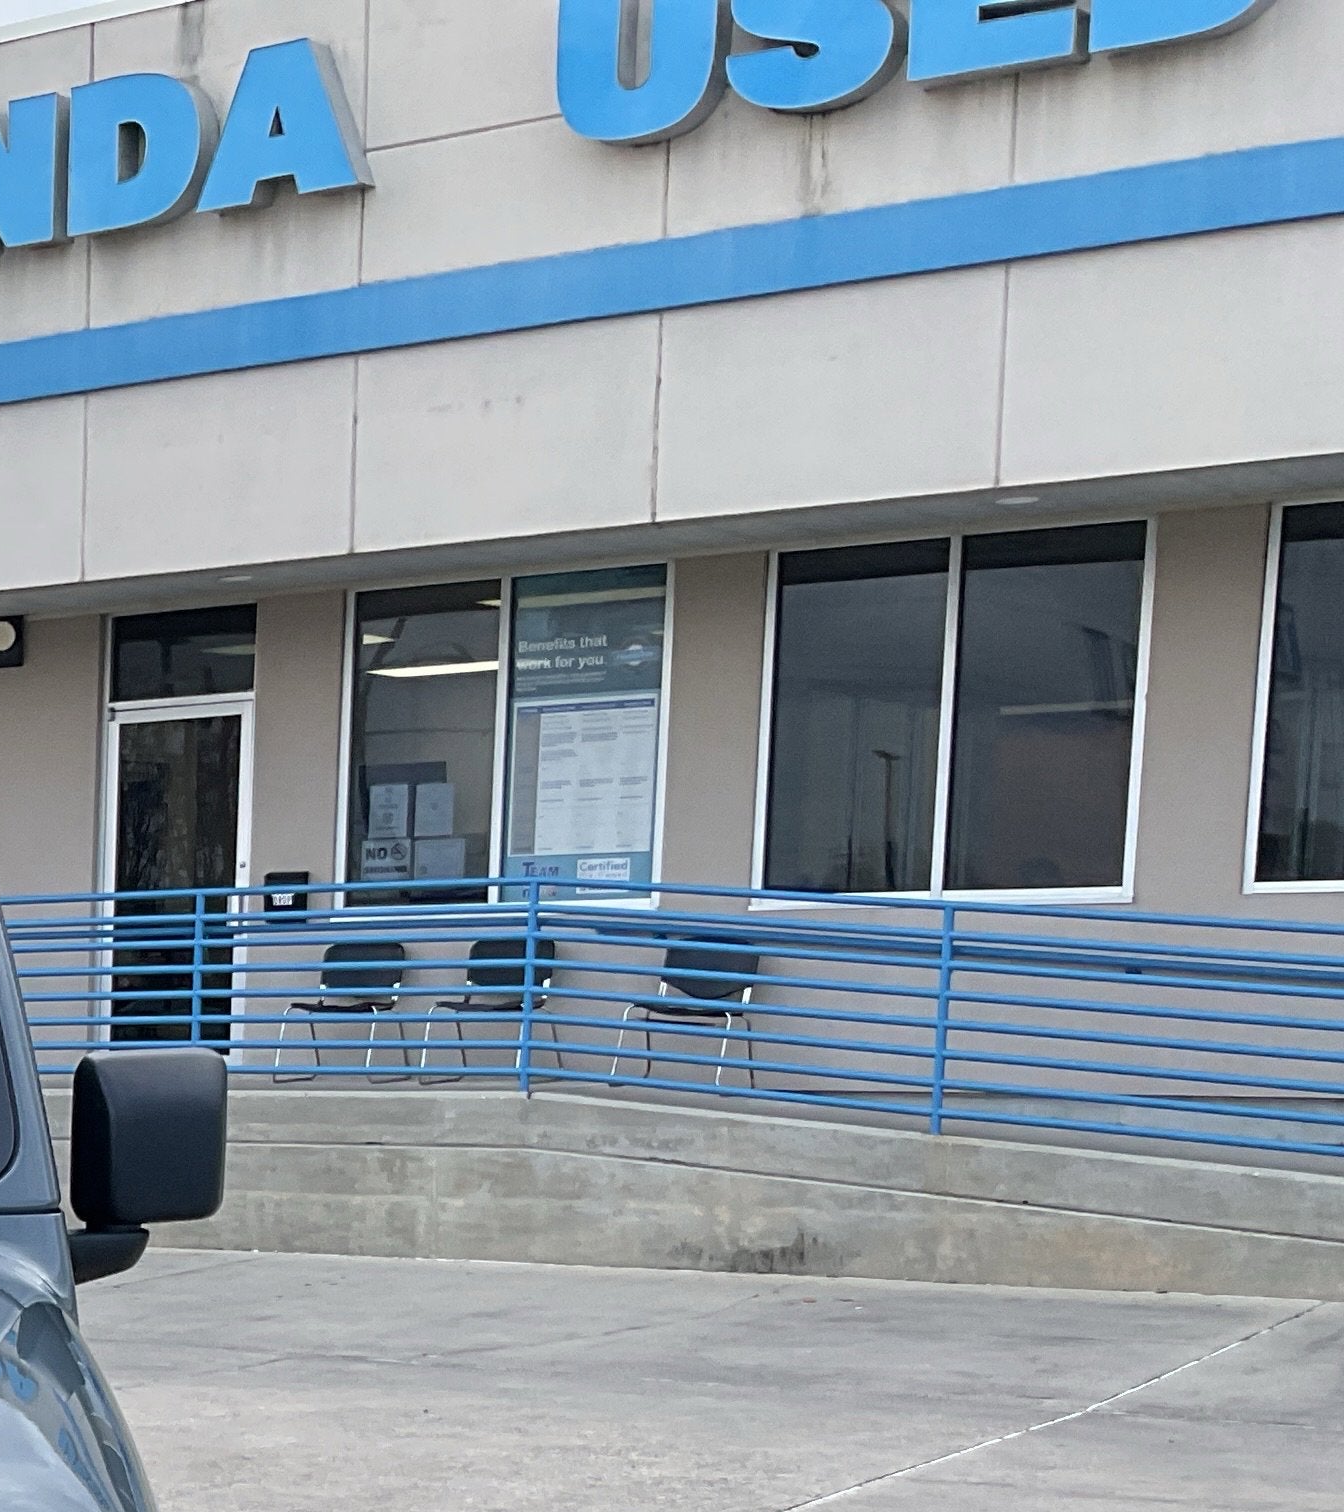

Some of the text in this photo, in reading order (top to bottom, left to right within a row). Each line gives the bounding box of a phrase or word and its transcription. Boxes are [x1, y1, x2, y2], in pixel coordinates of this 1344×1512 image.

[556, 0, 1279, 147] US
[518, 635, 608, 653] Benefits that
[516, 655, 604, 670] work for you
[365, 847, 388, 860] NO
[522, 861, 560, 877] TEAM
[579, 860, 628, 872] Certified
